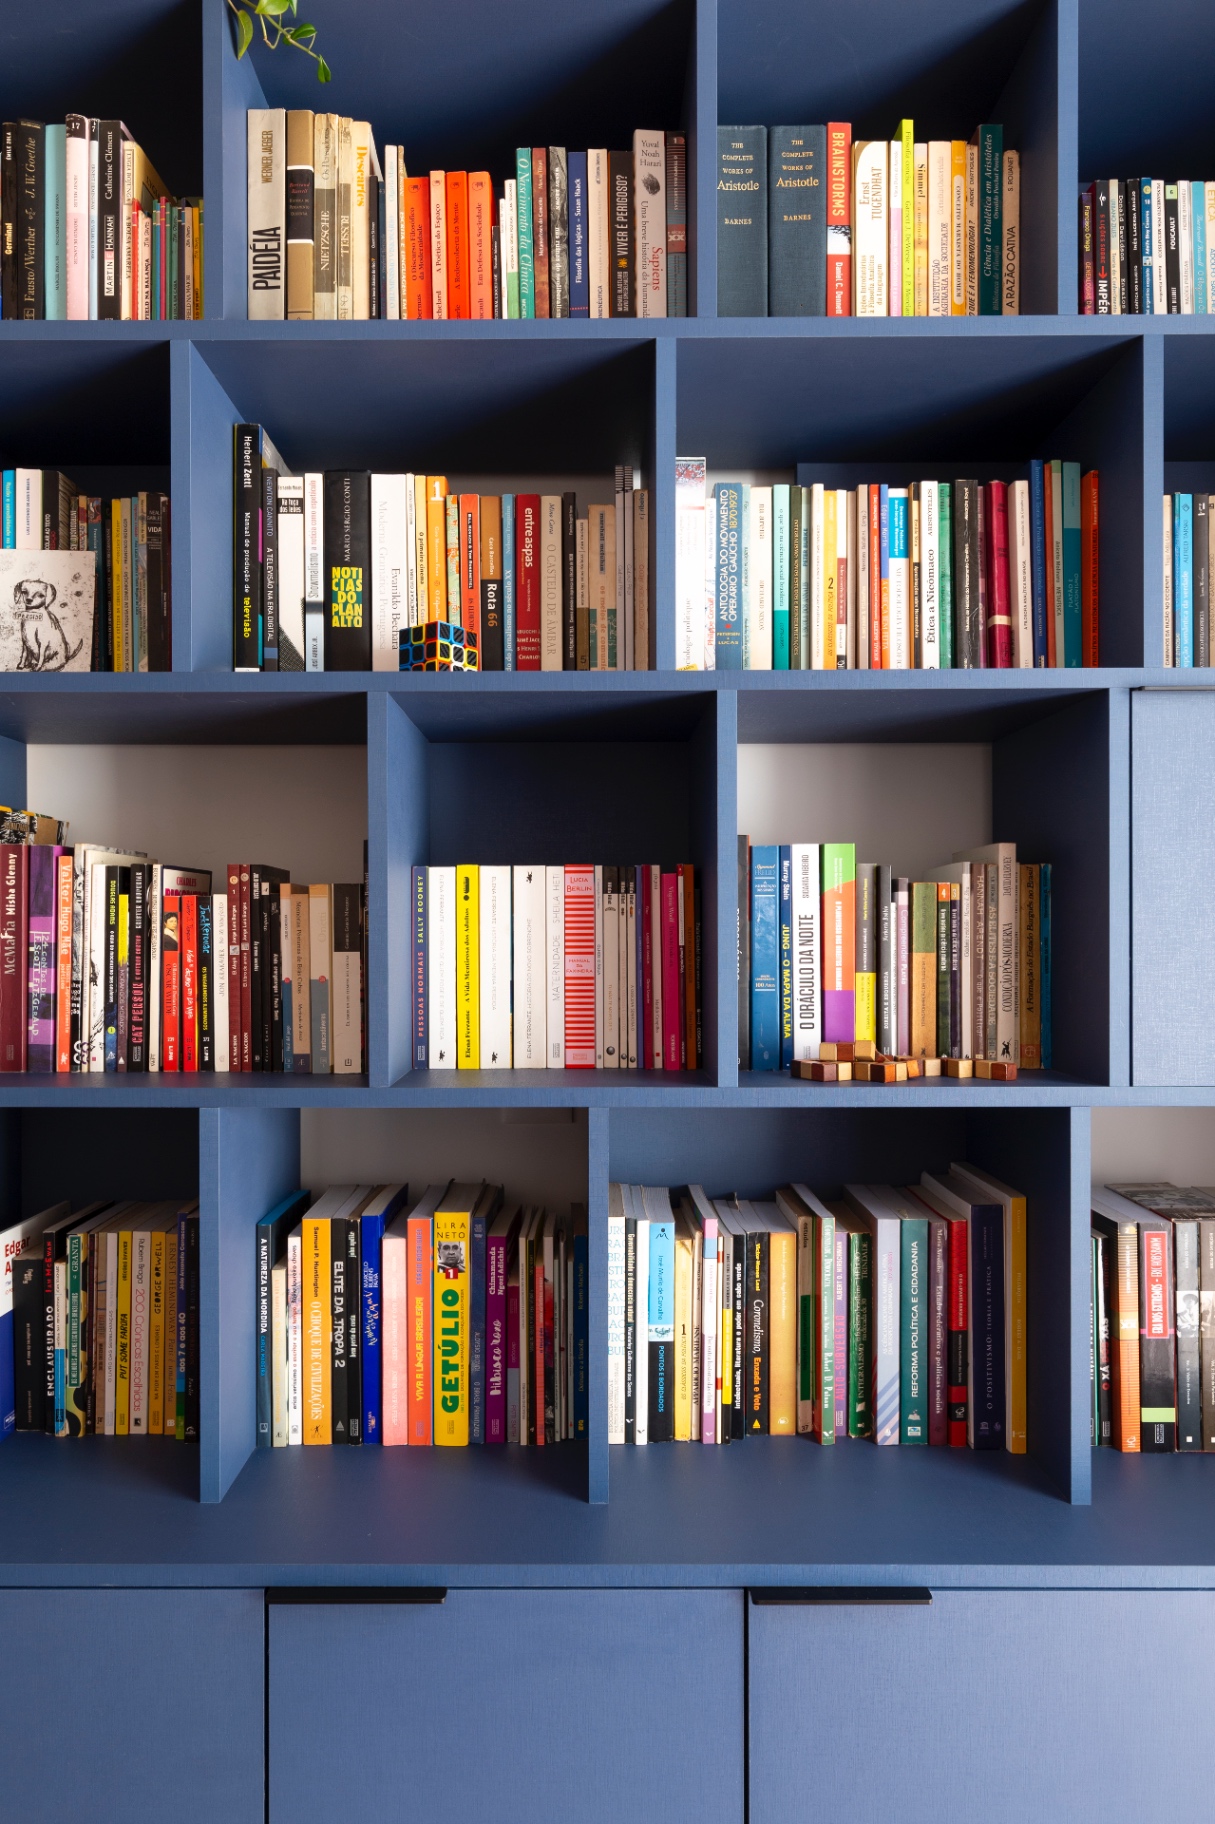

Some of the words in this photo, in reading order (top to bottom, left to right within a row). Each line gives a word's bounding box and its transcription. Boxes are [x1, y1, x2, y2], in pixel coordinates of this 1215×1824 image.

[23, 138, 35, 172] Goethe
[105, 131, 113, 162] Clément
[262, 131, 273, 154] JAEGER
[641, 150, 659, 158] Noah
[642, 140, 659, 148] Yuval
[262, 156, 273, 183] WERNER
[356, 146, 368, 206] Descartes
[519, 158, 528, 168] O
[640, 159, 661, 167] Harari
[832, 132, 845, 216] BRAINSTORMS
[23, 174, 35, 184] W.
[105, 164, 113, 199] Catherine
[575, 178, 583, 196] Haack
[717, 180, 759, 190] Aristotle
[776, 177, 819, 187] Aristotle
[917, 164, 925, 198] Simmel
[23, 188, 35, 198] J.
[519, 171, 530, 232] Nascimento
[616, 175, 628, 222] PERIGOSO?
[859, 182, 870, 205] Ernst
[871, 167, 882, 220] TUGENDHAT
[575, 198, 583, 216] Susan
[5, 223, 13, 255] Germinal
[321, 211, 330, 271] NIETZSCHE
[520, 235, 530, 249] da
[575, 224, 583, 244] lógicas
[617, 231, 628, 255] VIVER
[1006, 226, 1016, 260] CATIVA
[24, 227, 35, 302] Fausto/Werther
[250, 227, 280, 290] PAIDÉIA
[575, 246, 583, 257] das
[521, 254, 532, 294] Clínica
[575, 258, 583, 283] Filosofia
[649, 247, 663, 291] Sapiens
[1005, 261, 1016, 299] RAZÃO
[243, 436, 252, 467] Herbert
[243, 468, 252, 488] Zettl
[720, 489, 728, 547] MOVIMENTO
[727, 489, 737, 529] 1870·1937
[720, 549, 728, 564] DO
[727, 531, 737, 572] GAÚCHO
[266, 554, 275, 589] TELEVISÃO
[332, 567, 362, 579] NOTI
[926, 549, 935, 603] Nicômaco
[266, 591, 274, 600] NA
[332, 579, 362, 592] CIAS
[337, 592, 356, 603] DO
[391, 568, 400, 610] Evanildo
[488, 583, 497, 610] Rota
[720, 565, 728, 621] ANTOLOGIA
[727, 576, 737, 621] OPERÁRIO
[243, 597, 251, 638] televisão
[266, 602, 274, 614] ERA
[332, 603, 362, 616] PLAN
[332, 615, 362, 627] ALTO
[488, 613, 497, 627] 66
[266, 616, 274, 641] DIGITAL
[391, 613, 400, 650] Bechara
[924, 616, 935, 644] Ética
[7, 853, 17, 885] Glenny
[782, 860, 790, 881] Murray
[61, 865, 71, 903] Valter
[782, 884, 790, 900] Stein
[7, 888, 17, 915] Misha
[60, 906, 71, 932] Hugo
[799, 914, 814, 946] NOITE
[61, 936, 71, 955] Mãe
[782, 924, 790, 949] JUNG
[1000, 922, 1014, 973] PÓS-MODERNA
[799, 950, 814, 965] DA
[782, 969, 790, 994] MAPA
[797, 968, 815, 1019] ORÁCULO
[1000, 974, 1014, 1012] CONDIÇÃO
[132, 982, 143, 1021] PERSON
[783, 997, 791, 1010] DA
[132, 1024, 143, 1043] CAT
[783, 1012, 791, 1038] ALMA
[71, 1238, 79, 1272] GRANTA
[137, 1239, 145, 1262] Rubem
[497, 1247, 505, 1273] Adichie
[136, 1264, 145, 1284] Braga
[334, 1261, 344, 1293] ELITE
[497, 1275, 505, 1295] Ngozi
[260, 1287, 267, 1297] DA
[334, 1296, 344, 1313] DA
[119, 1313, 128, 1340] FAROFA
[309, 1309, 323, 1345] CHOQUE
[334, 1319, 344, 1355] TROPA
[752, 1300, 764, 1354] Coronelismo,
[909, 1305, 919, 1348] POLÍTICA
[1101, 1318, 1110, 1339] XÁS
[46, 1306, 54, 1396] ENCLAUSURADO
[119, 1342, 128, 1363] SOME
[311, 1348, 323, 1360] DE
[438, 1289, 459, 1413] GETÚLIO
[834, 1315, 845, 1400] AUTO-SUBVERSÃO
[1101, 1342, 1110, 1362] DOS
[119, 1365, 128, 1379] PUT
[753, 1357, 761, 1385] Enxada
[911, 1351, 919, 1397] REFORMA
[1101, 1365, 1110, 1380] XÁ
[309, 1364, 324, 1420] CIVILIZAÇÕES
[753, 1394, 761, 1411] Voto
